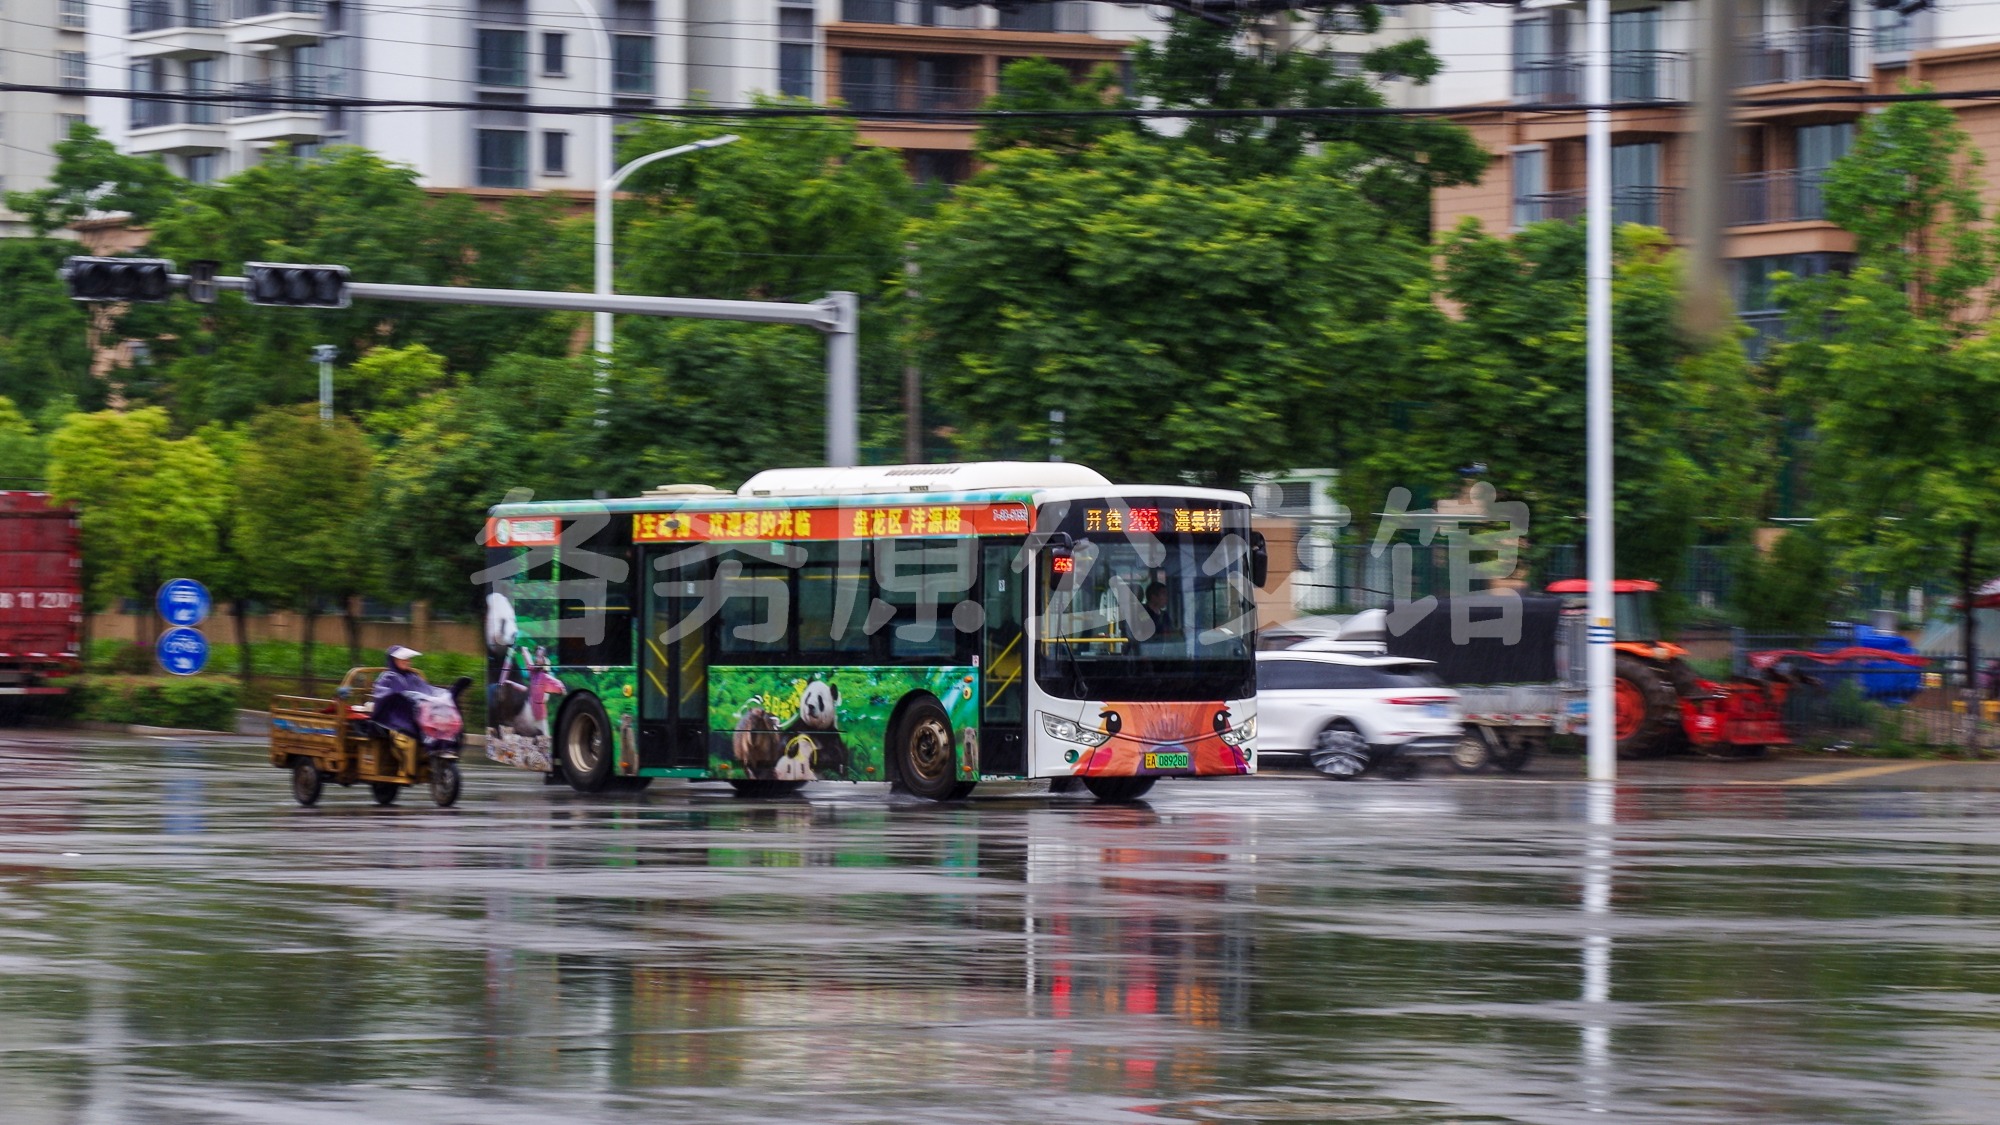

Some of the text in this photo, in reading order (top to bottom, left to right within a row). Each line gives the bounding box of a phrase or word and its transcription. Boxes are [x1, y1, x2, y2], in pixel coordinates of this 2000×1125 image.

[709, 510, 811, 537] 欢迎您的光临
[853, 509, 903, 536] 盘龙区
[1128, 508, 1159, 531] 265
[1054, 557, 1073, 572] 265
